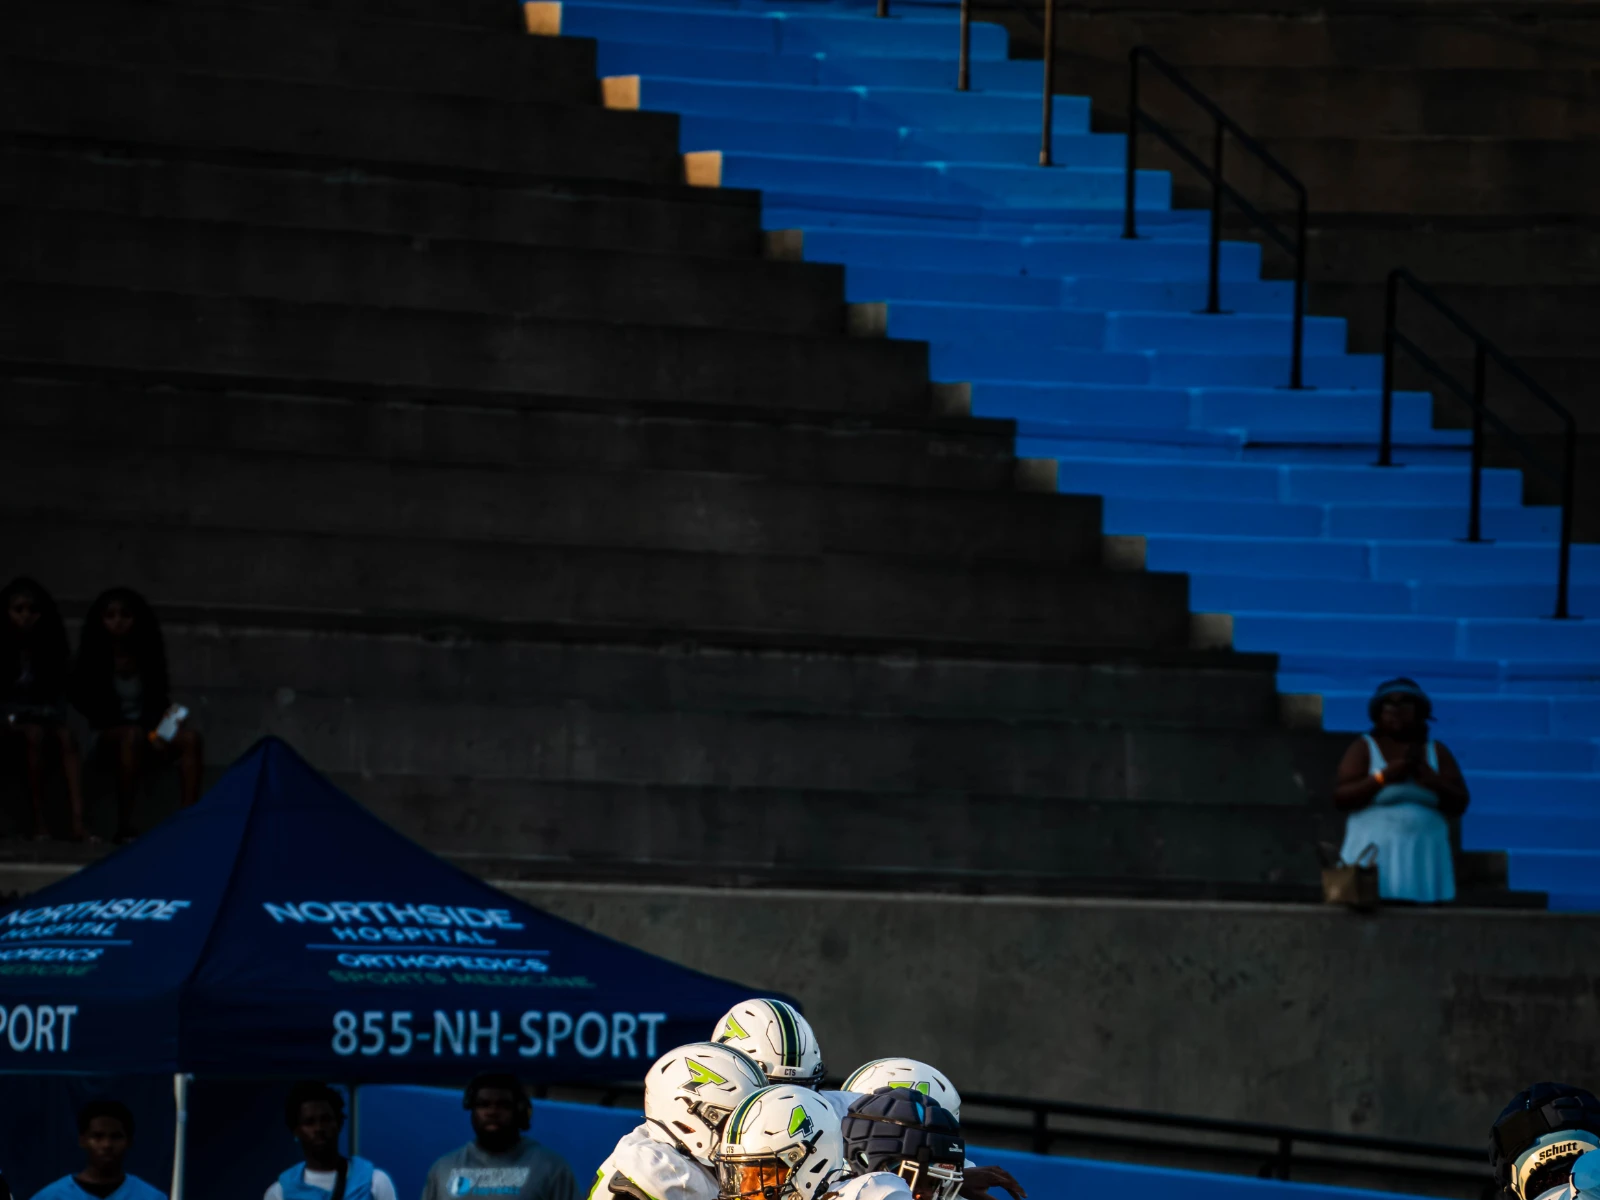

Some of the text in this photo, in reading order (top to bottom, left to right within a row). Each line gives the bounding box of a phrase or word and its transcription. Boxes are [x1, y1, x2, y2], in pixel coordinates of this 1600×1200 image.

[0, 898, 192, 926] NORTHSIDE
[262, 900, 527, 930] NORTHSIDE
[332, 925, 498, 946] HOSPITAL
[336, 953, 550, 974] ORTHOPEDICS
[331, 1009, 667, 1059] 855-NH-SPORT
[784, 1068, 796, 1077] CTS
[1539, 1142, 1578, 1161] schutt
